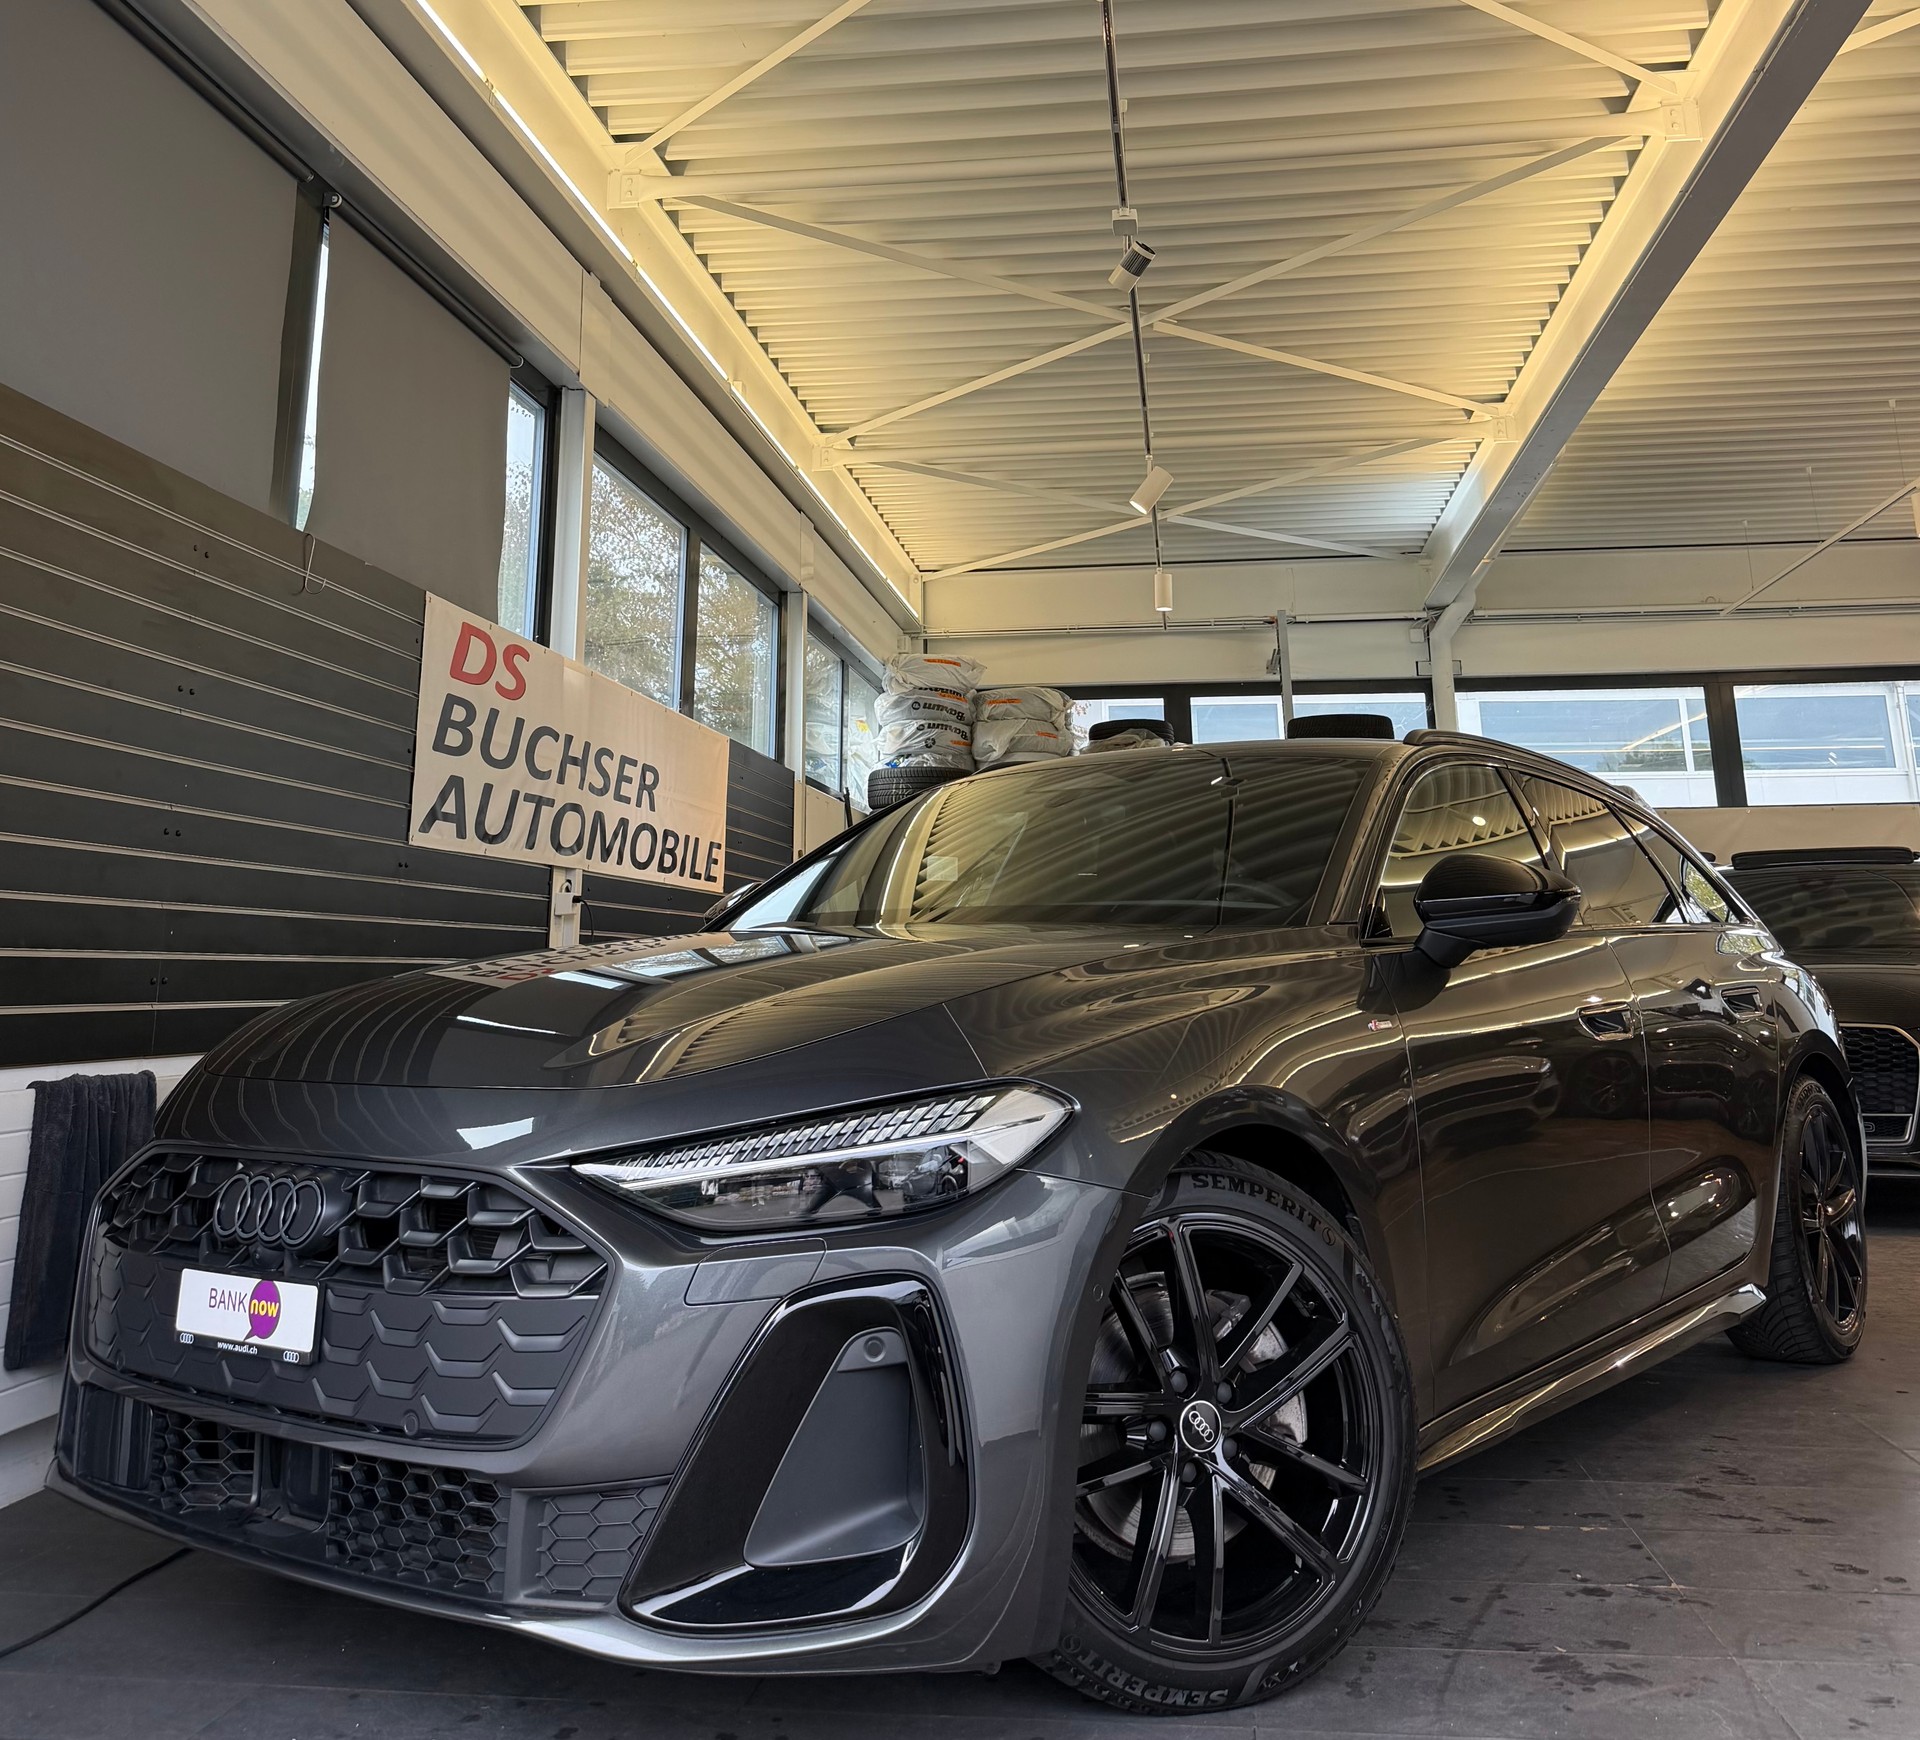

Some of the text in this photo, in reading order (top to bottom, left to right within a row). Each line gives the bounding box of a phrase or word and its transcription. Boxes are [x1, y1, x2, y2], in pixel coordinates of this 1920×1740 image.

[449, 621, 530, 701] DS
[431, 692, 660, 812] BUCHSER
[418, 774, 722, 883] AUTOMOBILE
[1191, 1172, 1323, 1232] SEMPERIT
[208, 1287, 280, 1317] BANK now
[217, 1341, 258, 1355] www.audi.ch
[1077, 1652, 1230, 1707] SEMPERIT
